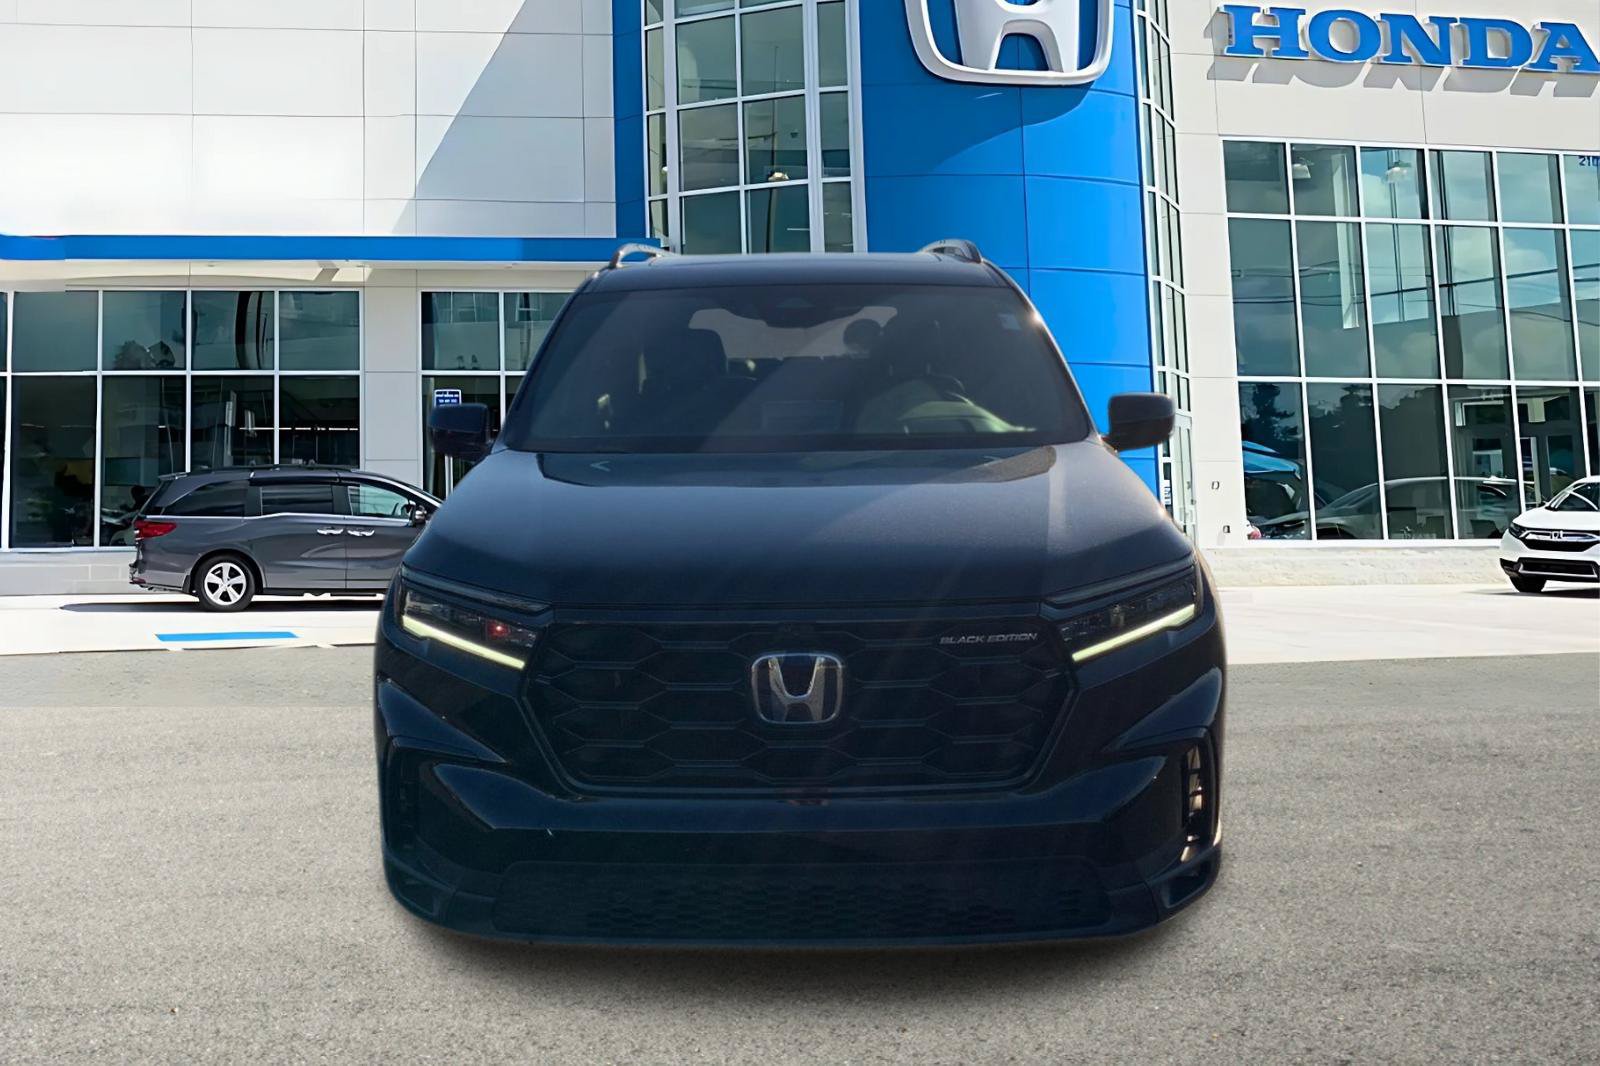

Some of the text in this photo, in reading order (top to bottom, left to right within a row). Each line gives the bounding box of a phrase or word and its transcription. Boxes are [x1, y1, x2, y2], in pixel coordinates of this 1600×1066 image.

[1223, 4, 1600, 74] HONDA
[940, 632, 1038, 645] BLACK EDITION
